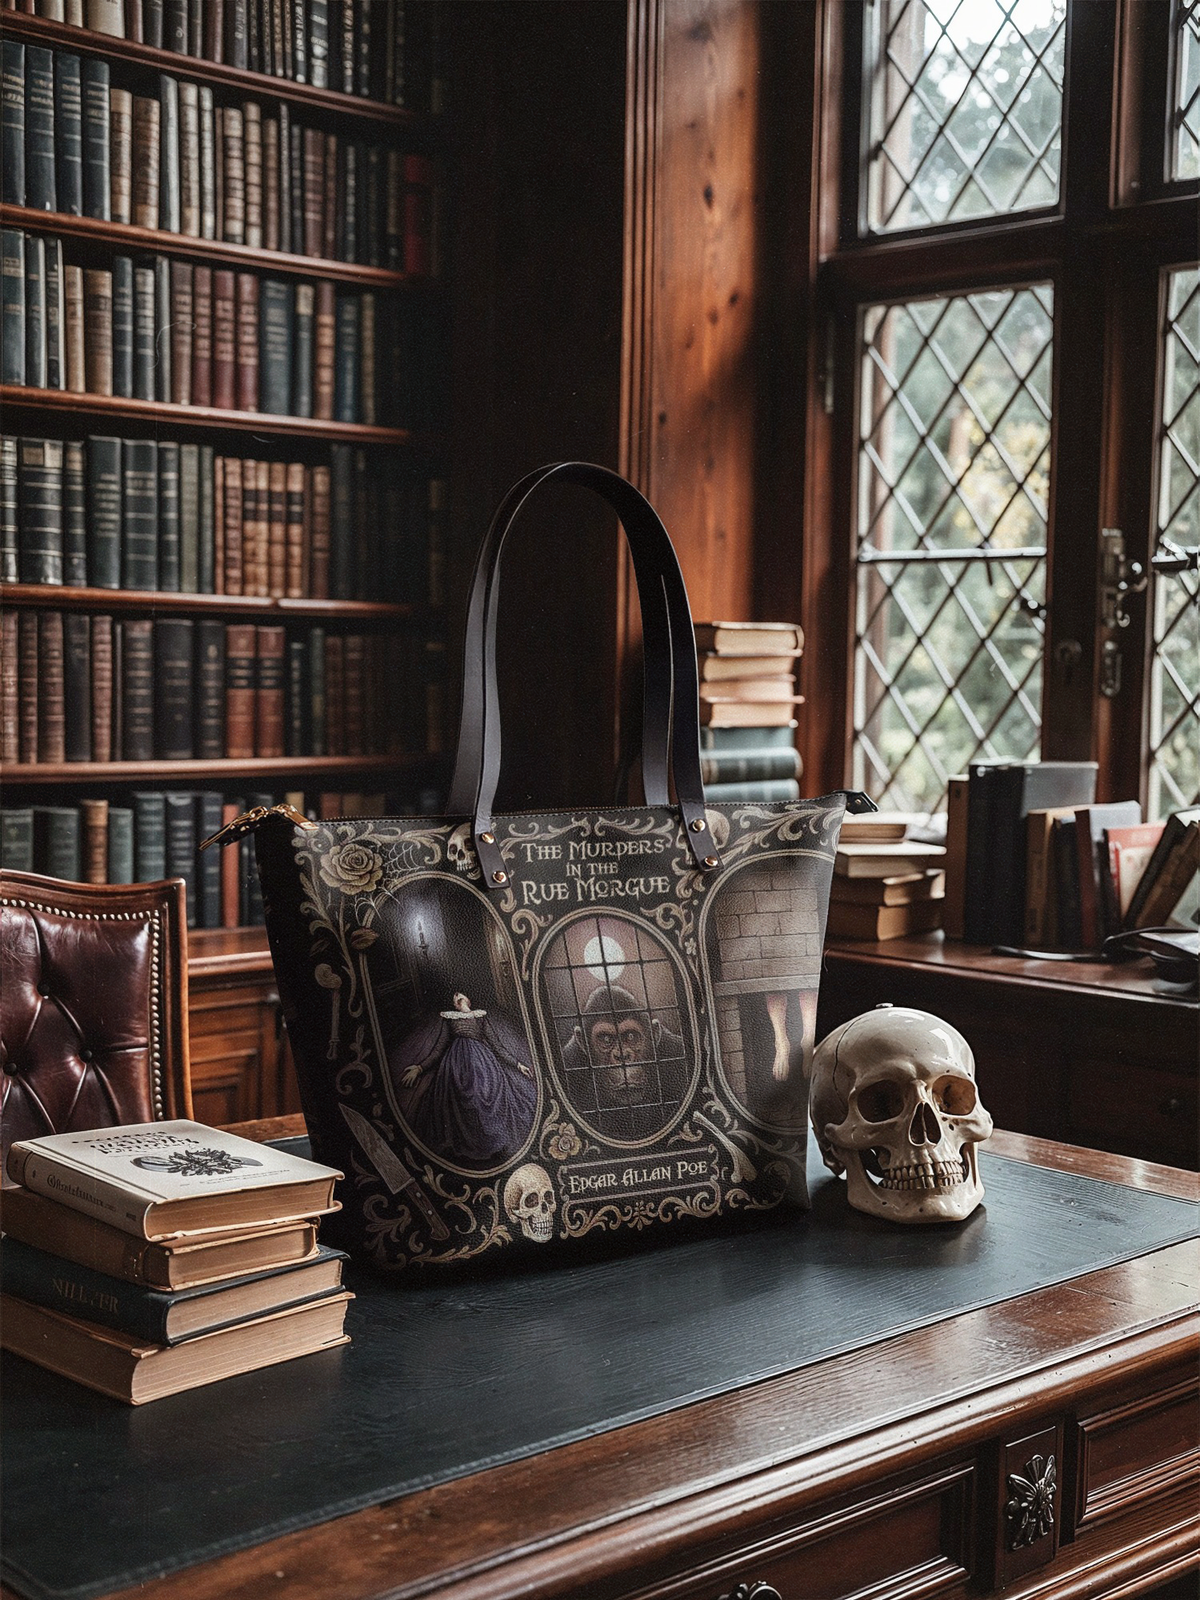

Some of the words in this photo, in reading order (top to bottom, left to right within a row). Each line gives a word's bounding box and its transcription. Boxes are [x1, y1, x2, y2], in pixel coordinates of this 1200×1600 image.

[520, 842, 563, 863] THE
[568, 839, 665, 862] MURDERS
[587, 861, 618, 875] THE
[521, 880, 570, 905] RUE
[576, 875, 671, 902] MORGUE
[568, 1173, 618, 1194] EDGAR
[621, 1165, 671, 1187] ALLAN
[676, 1161, 708, 1179] POE
